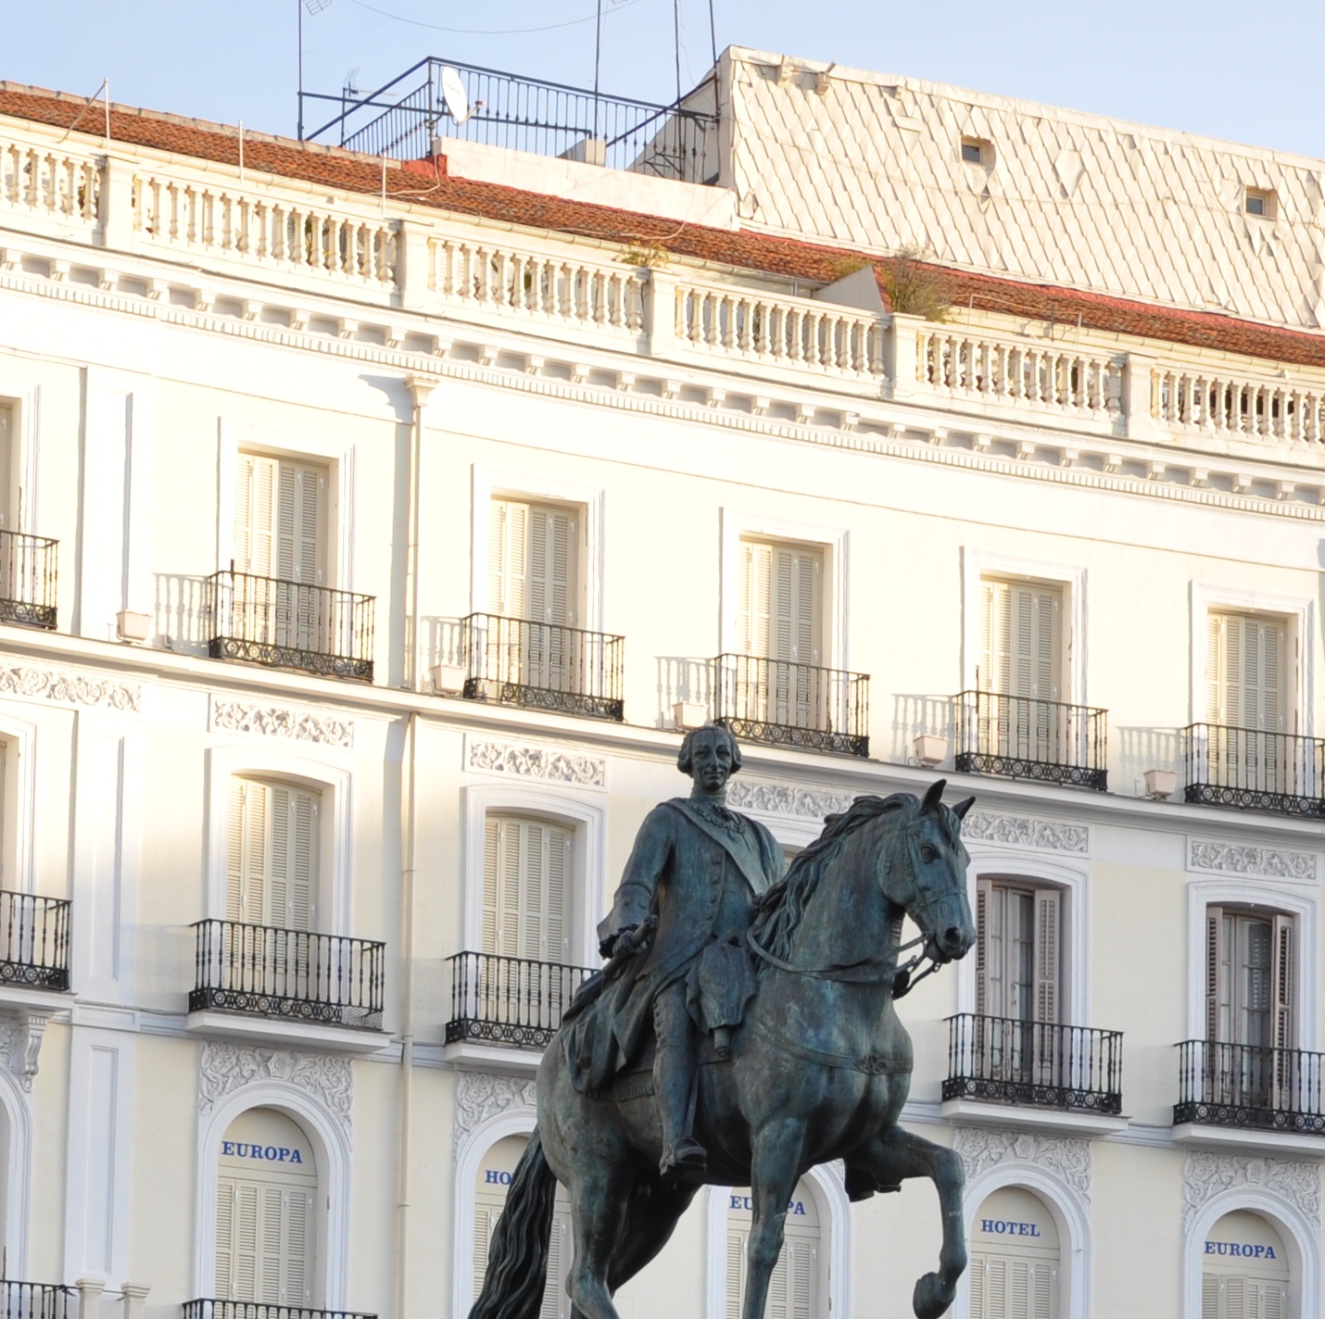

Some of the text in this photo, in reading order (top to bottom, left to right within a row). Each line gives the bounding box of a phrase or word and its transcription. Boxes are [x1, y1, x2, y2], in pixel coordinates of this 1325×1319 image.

[221, 1140, 304, 1165] EUROPA
[729, 1195, 807, 1216] EUPA
[980, 1219, 1041, 1239] HOTEL
[1204, 1240, 1277, 1261] EUROPA
